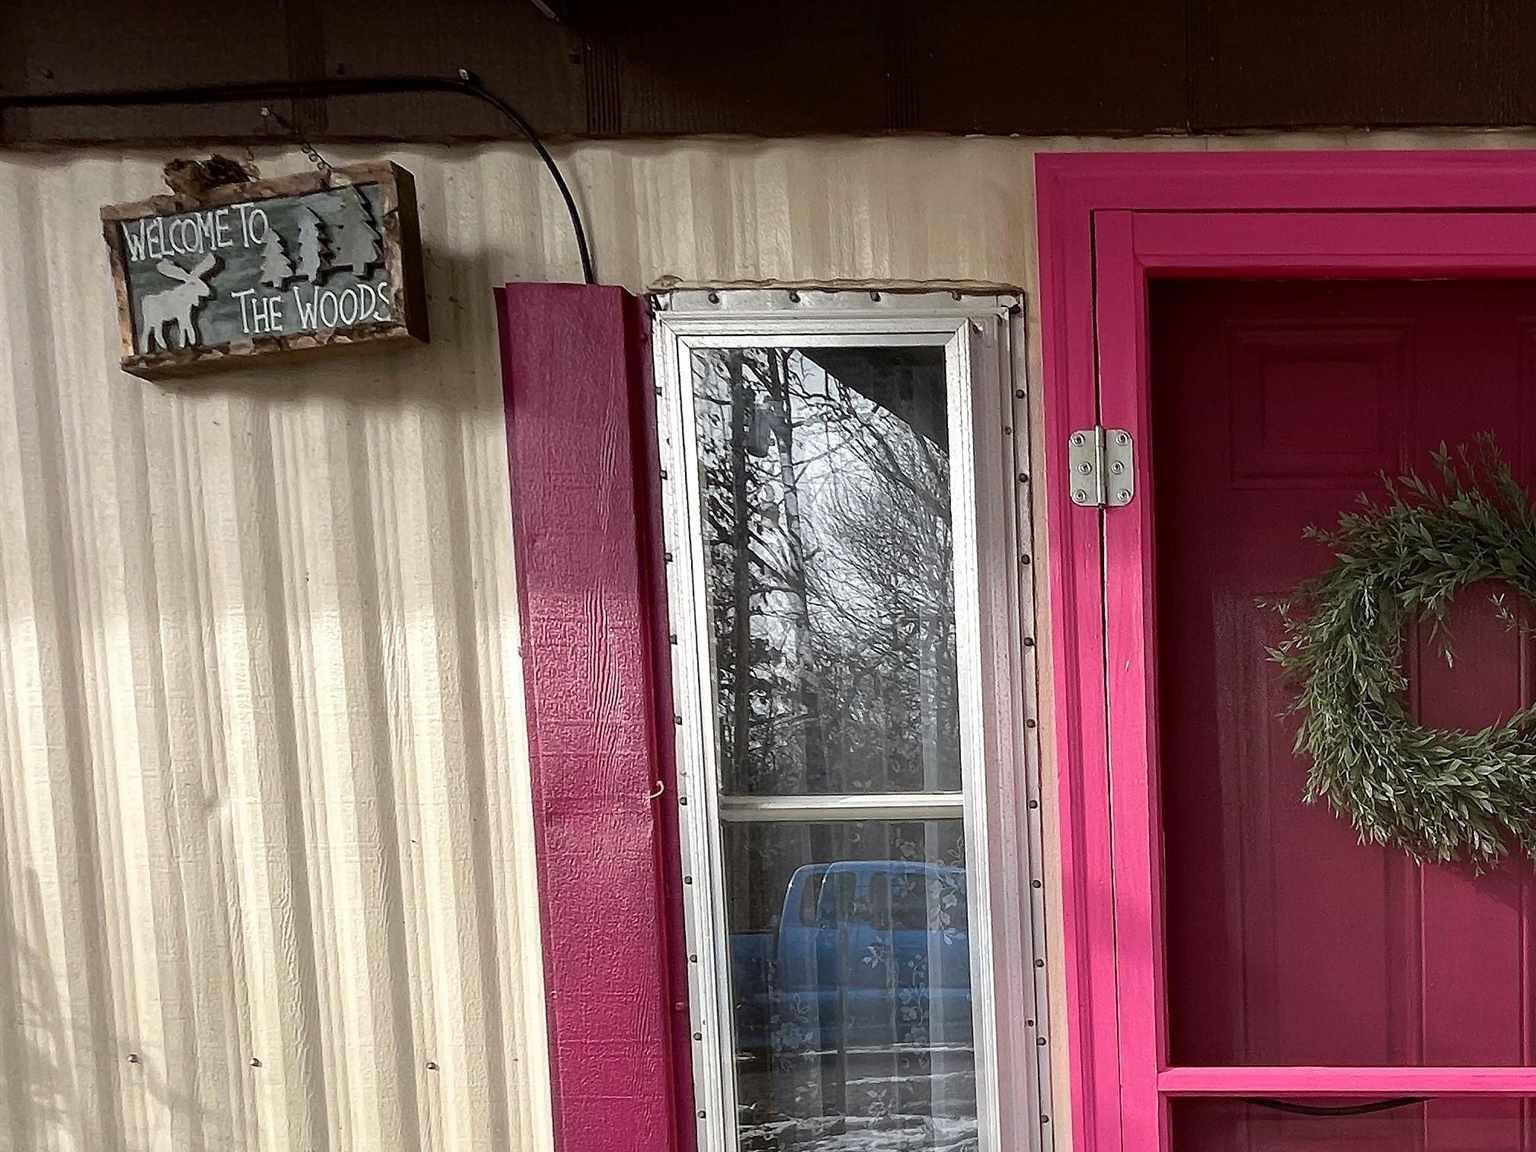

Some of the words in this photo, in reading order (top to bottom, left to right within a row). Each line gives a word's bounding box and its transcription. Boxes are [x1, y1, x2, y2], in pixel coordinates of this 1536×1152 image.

[121, 207, 233, 262] WELCOME
[230, 202, 269, 249] TO
[231, 288, 284, 335] THE
[294, 281, 392, 331] WOODS
